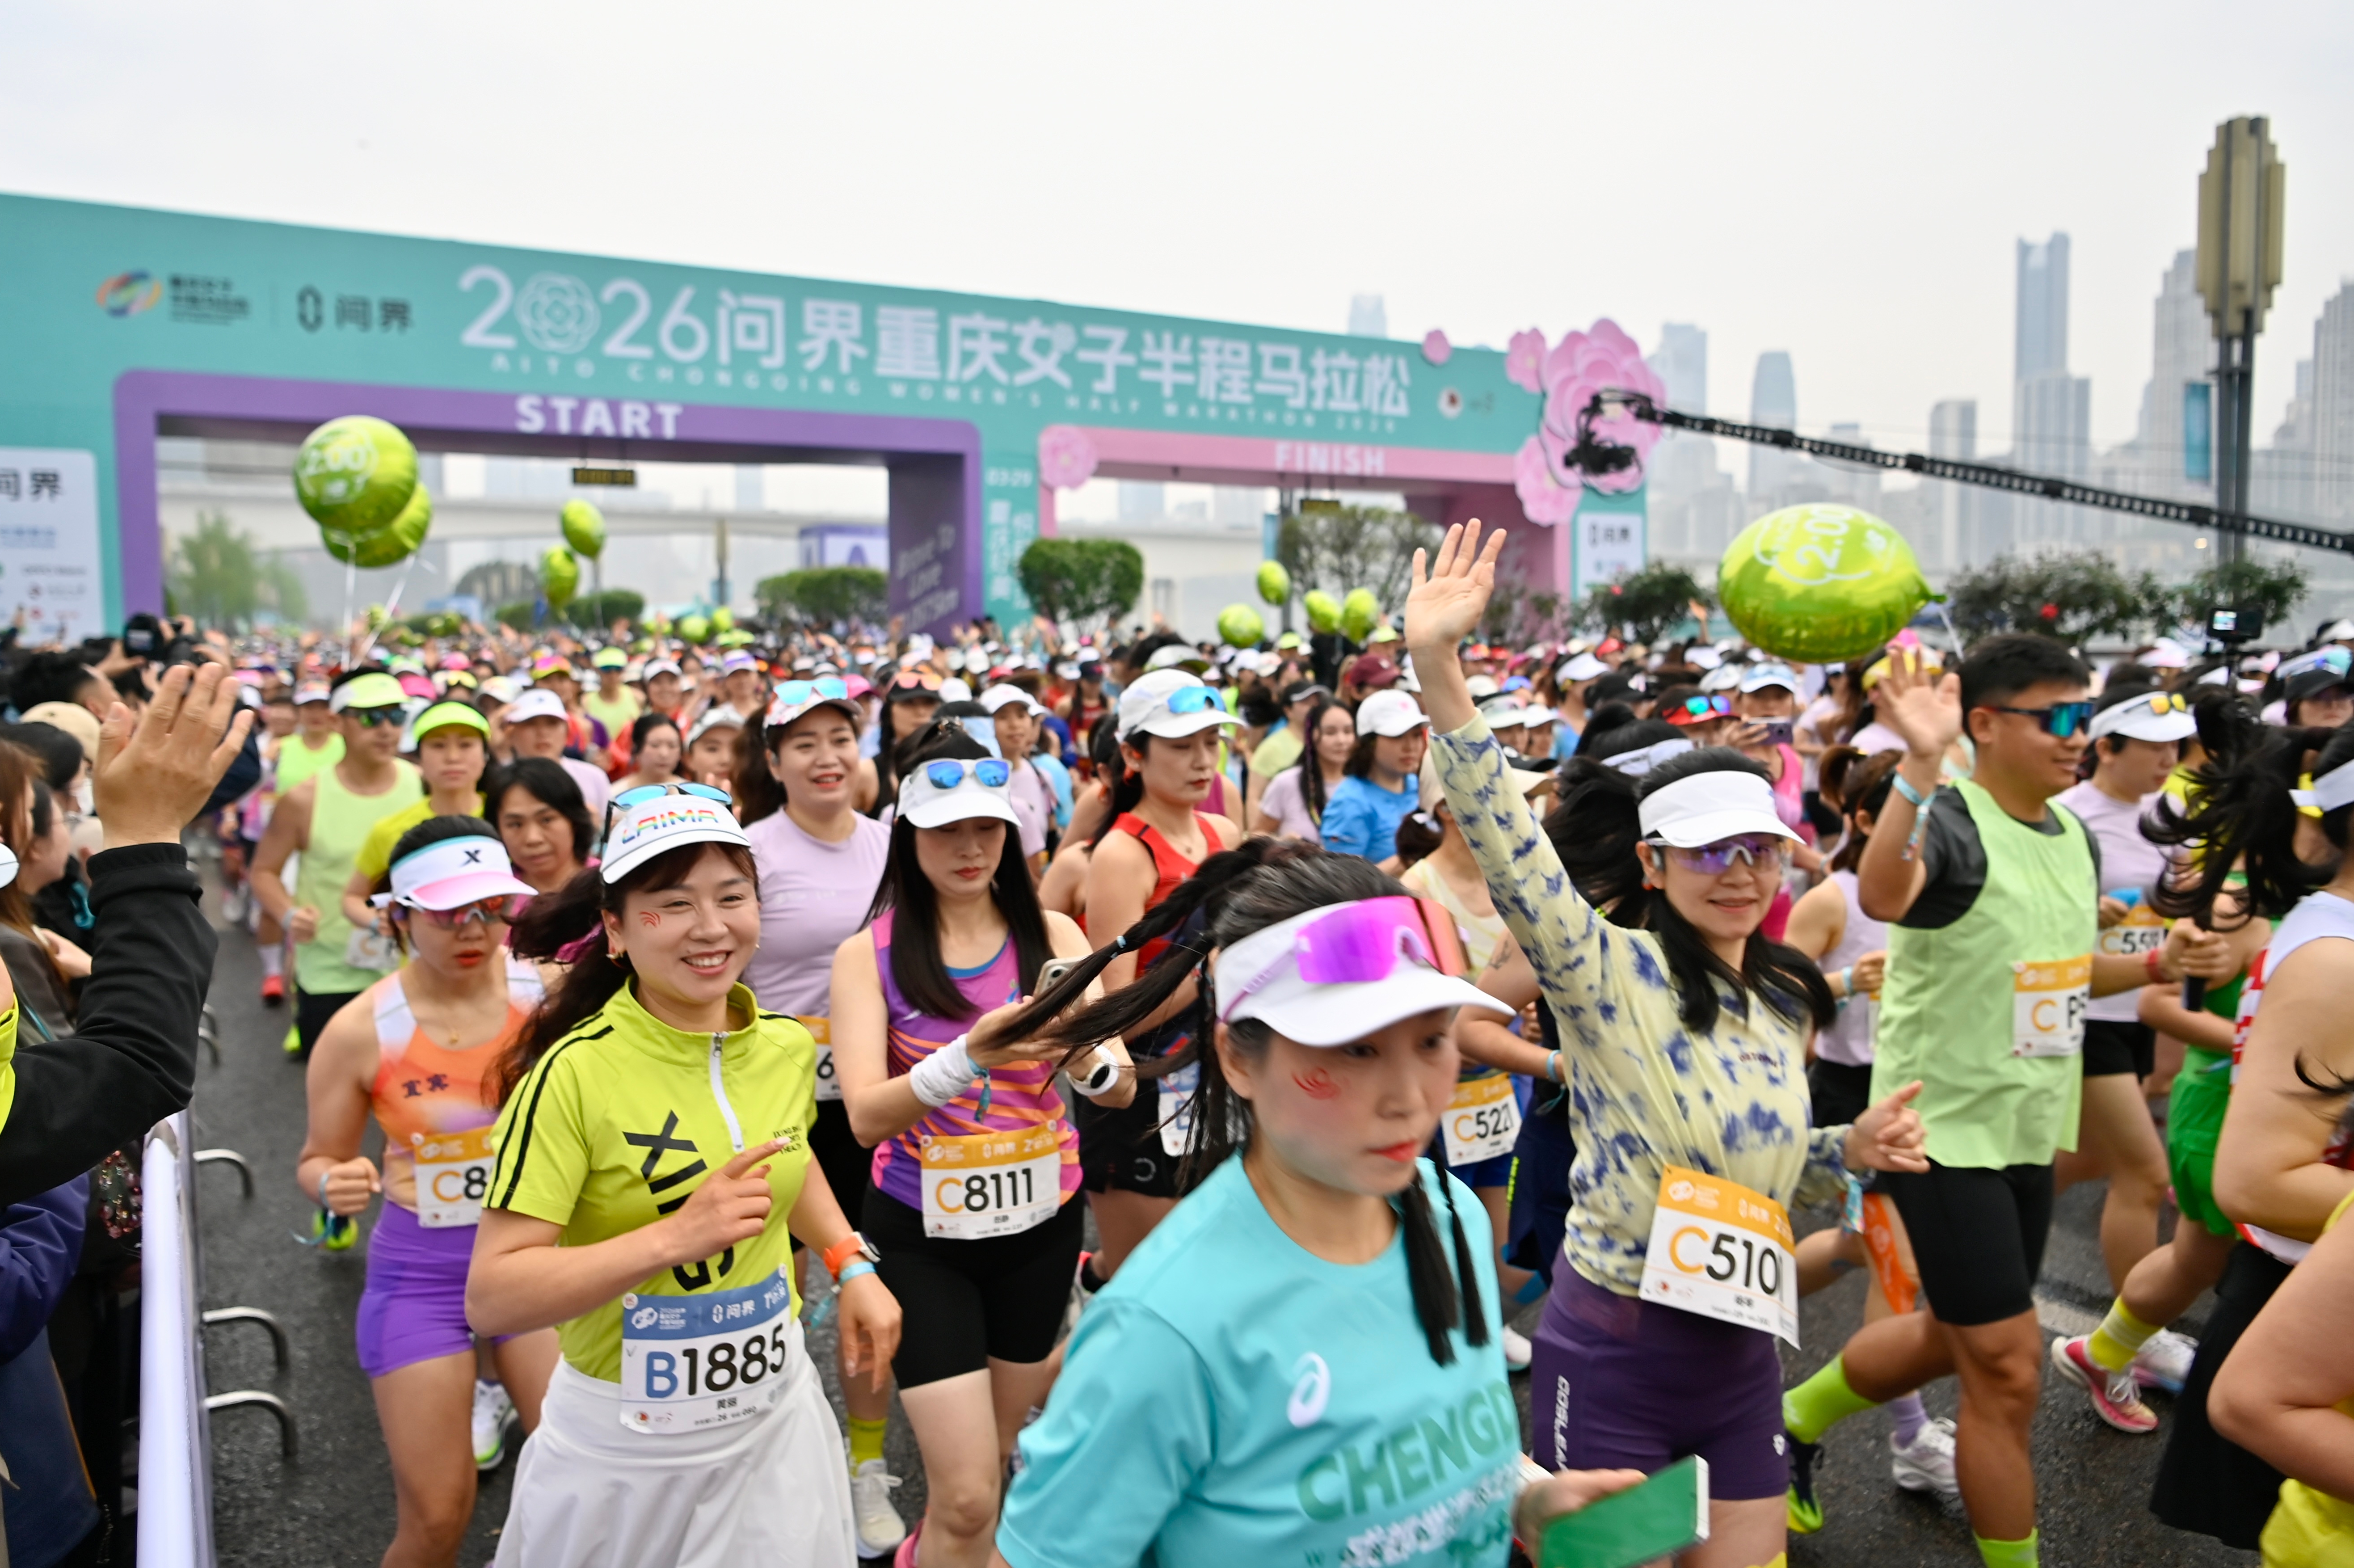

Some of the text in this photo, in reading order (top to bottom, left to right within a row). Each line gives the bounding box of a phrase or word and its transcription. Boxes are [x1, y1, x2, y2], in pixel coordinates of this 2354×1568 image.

[335, 293, 414, 333] 问界
[492, 353, 595, 379] AITO
[515, 395, 684, 439] START
[1275, 441, 1386, 476] FINISH
[935, 1168, 1034, 1214] C8111
[1669, 1225, 1783, 1295] C510
[646, 1323, 786, 1399] B1885
